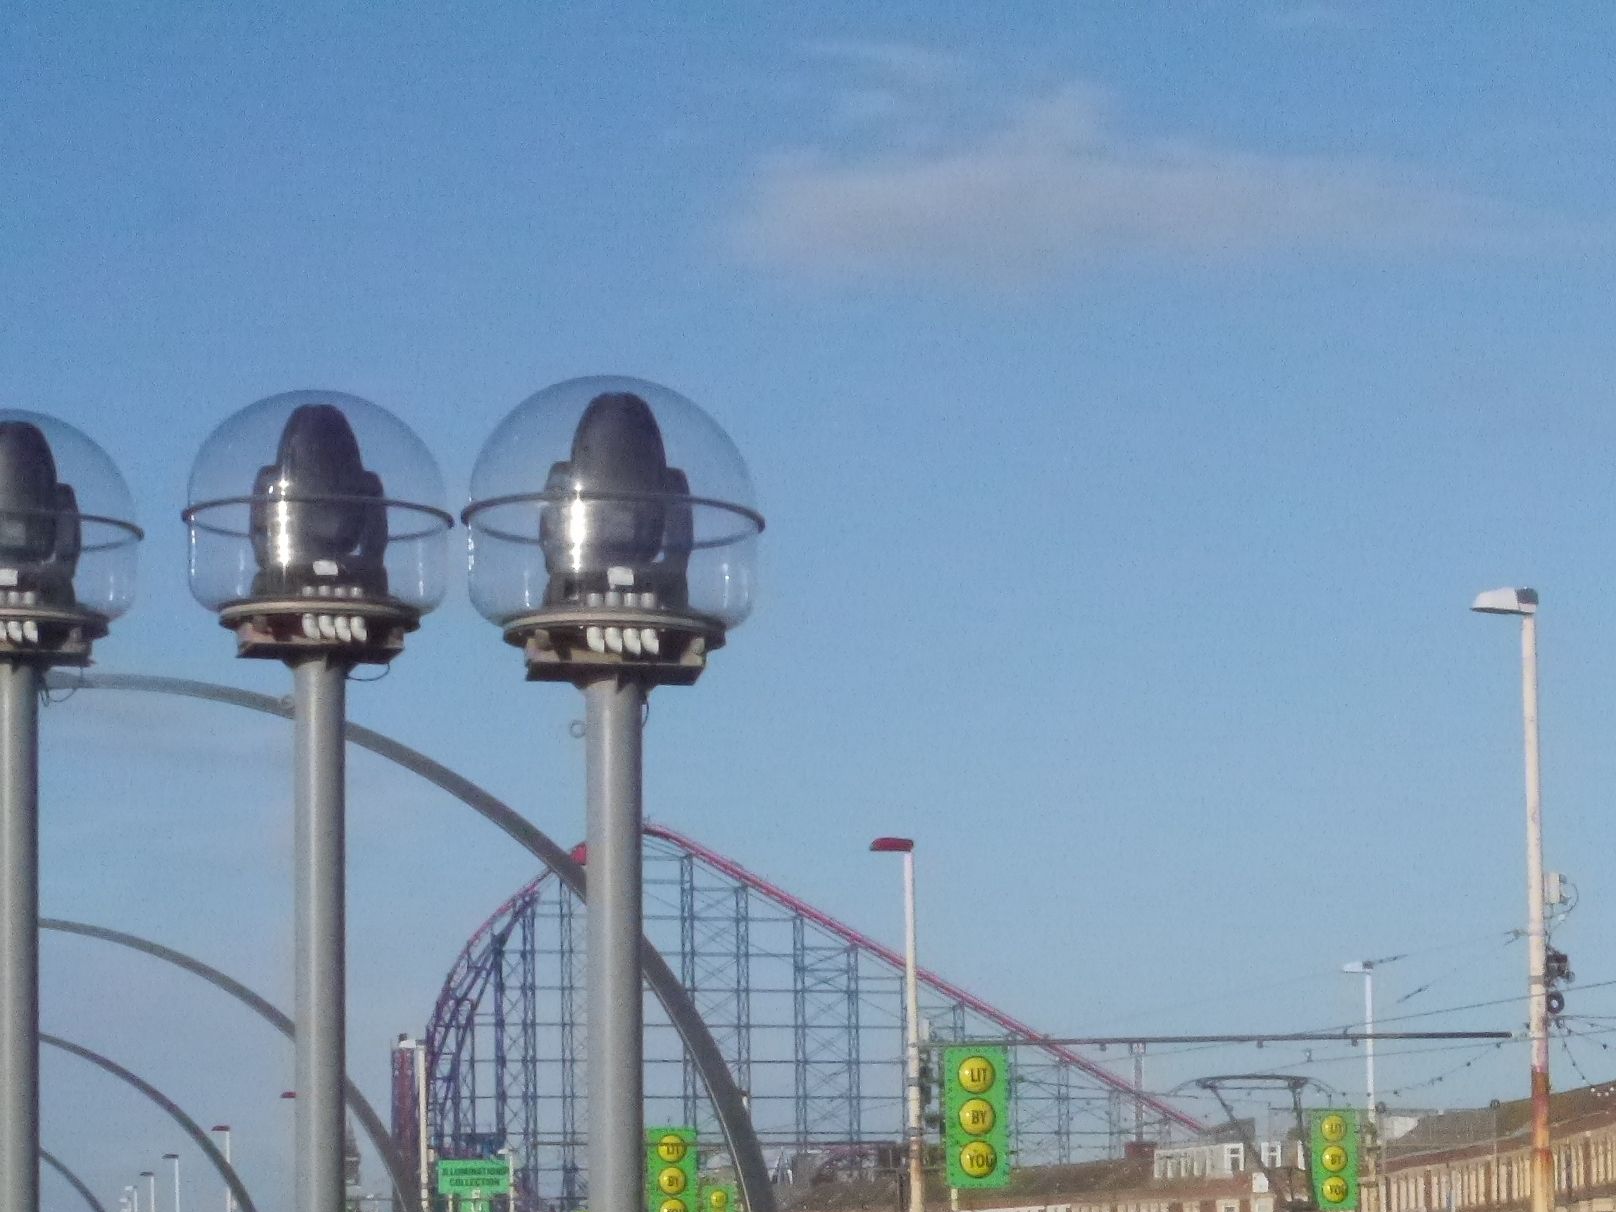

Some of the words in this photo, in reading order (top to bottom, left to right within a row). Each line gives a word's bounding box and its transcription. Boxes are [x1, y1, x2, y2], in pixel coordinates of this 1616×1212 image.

[970, 1068, 987, 1082] LIT
[971, 1110, 986, 1124] BY
[969, 1154, 993, 1168] YOU
